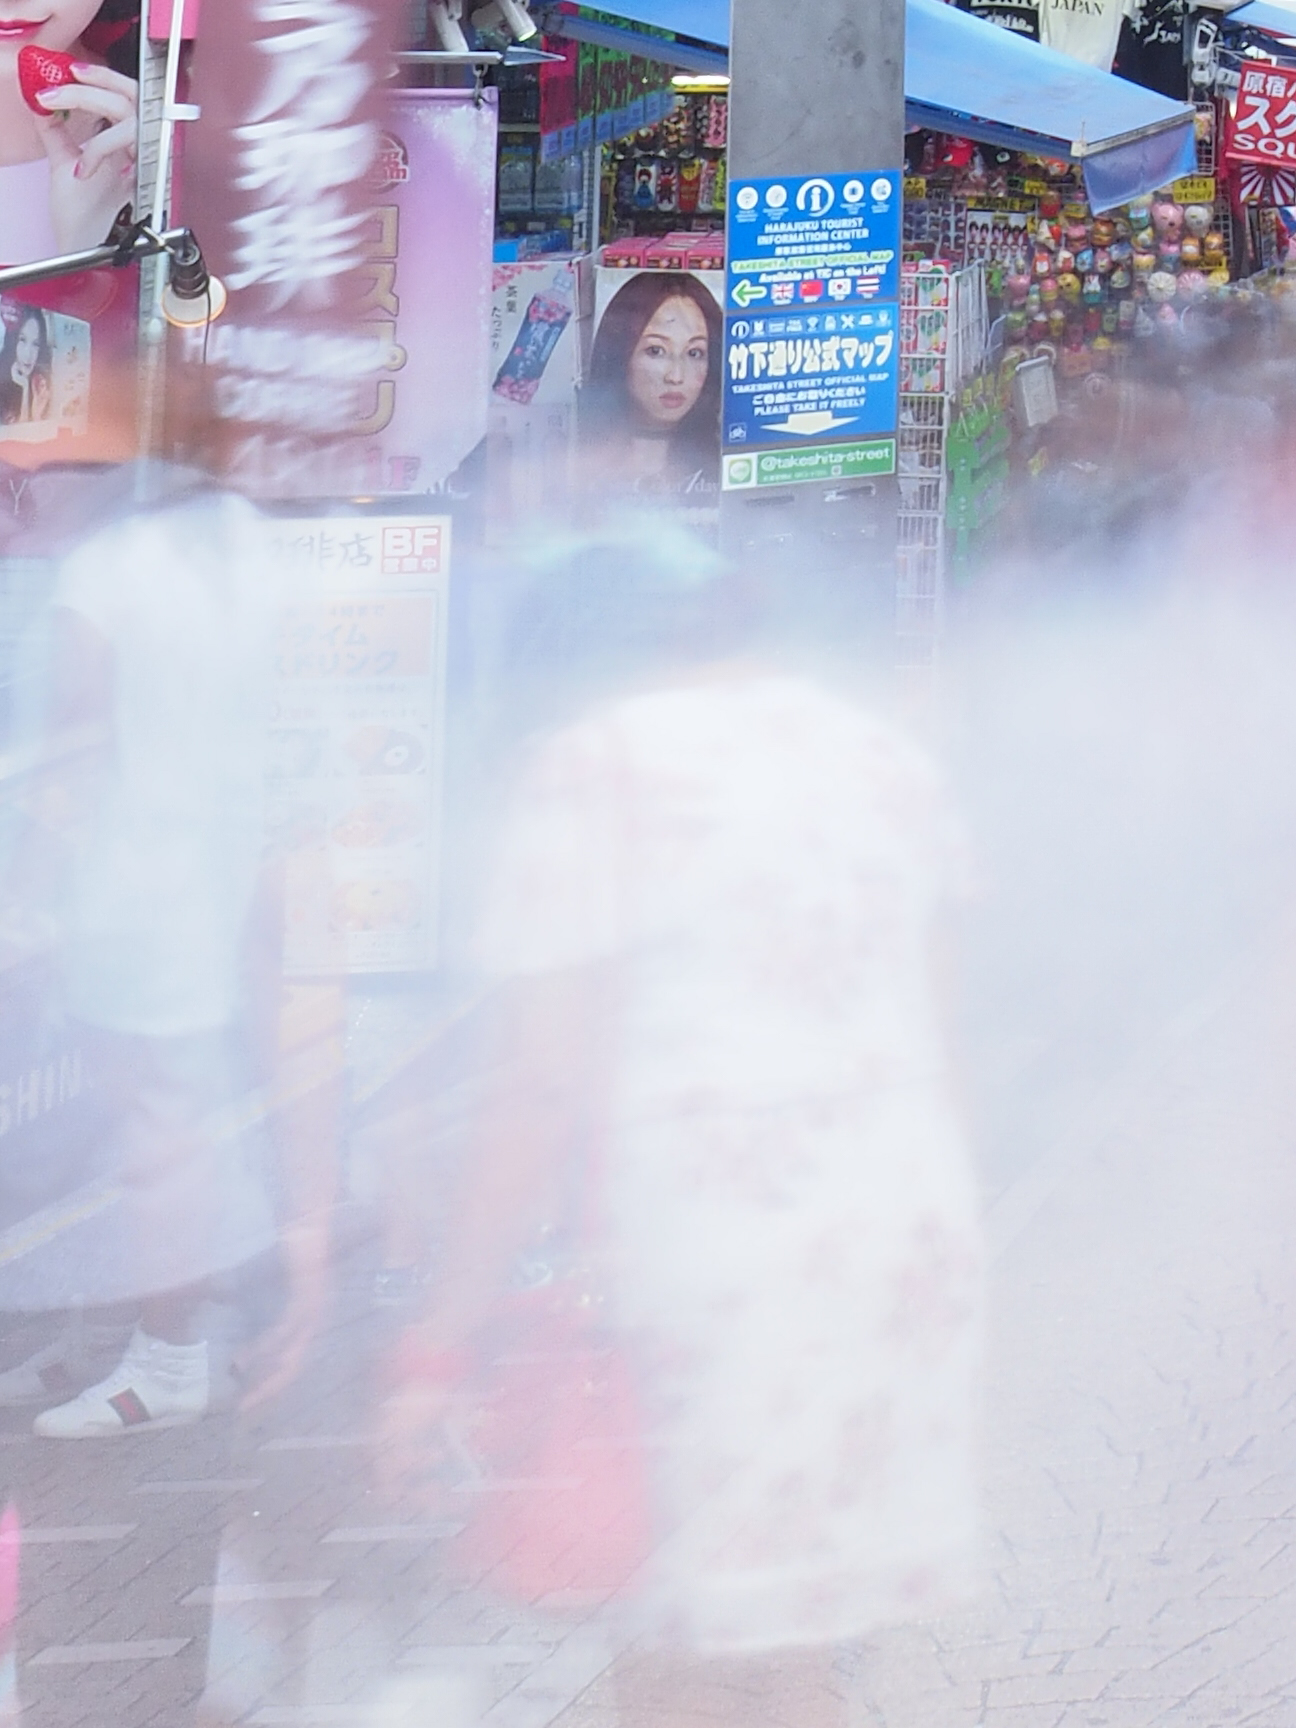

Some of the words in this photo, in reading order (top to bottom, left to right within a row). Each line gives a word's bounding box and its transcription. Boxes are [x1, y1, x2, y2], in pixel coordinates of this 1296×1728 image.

[728, 330, 895, 380] 竹下通り公式マップ
